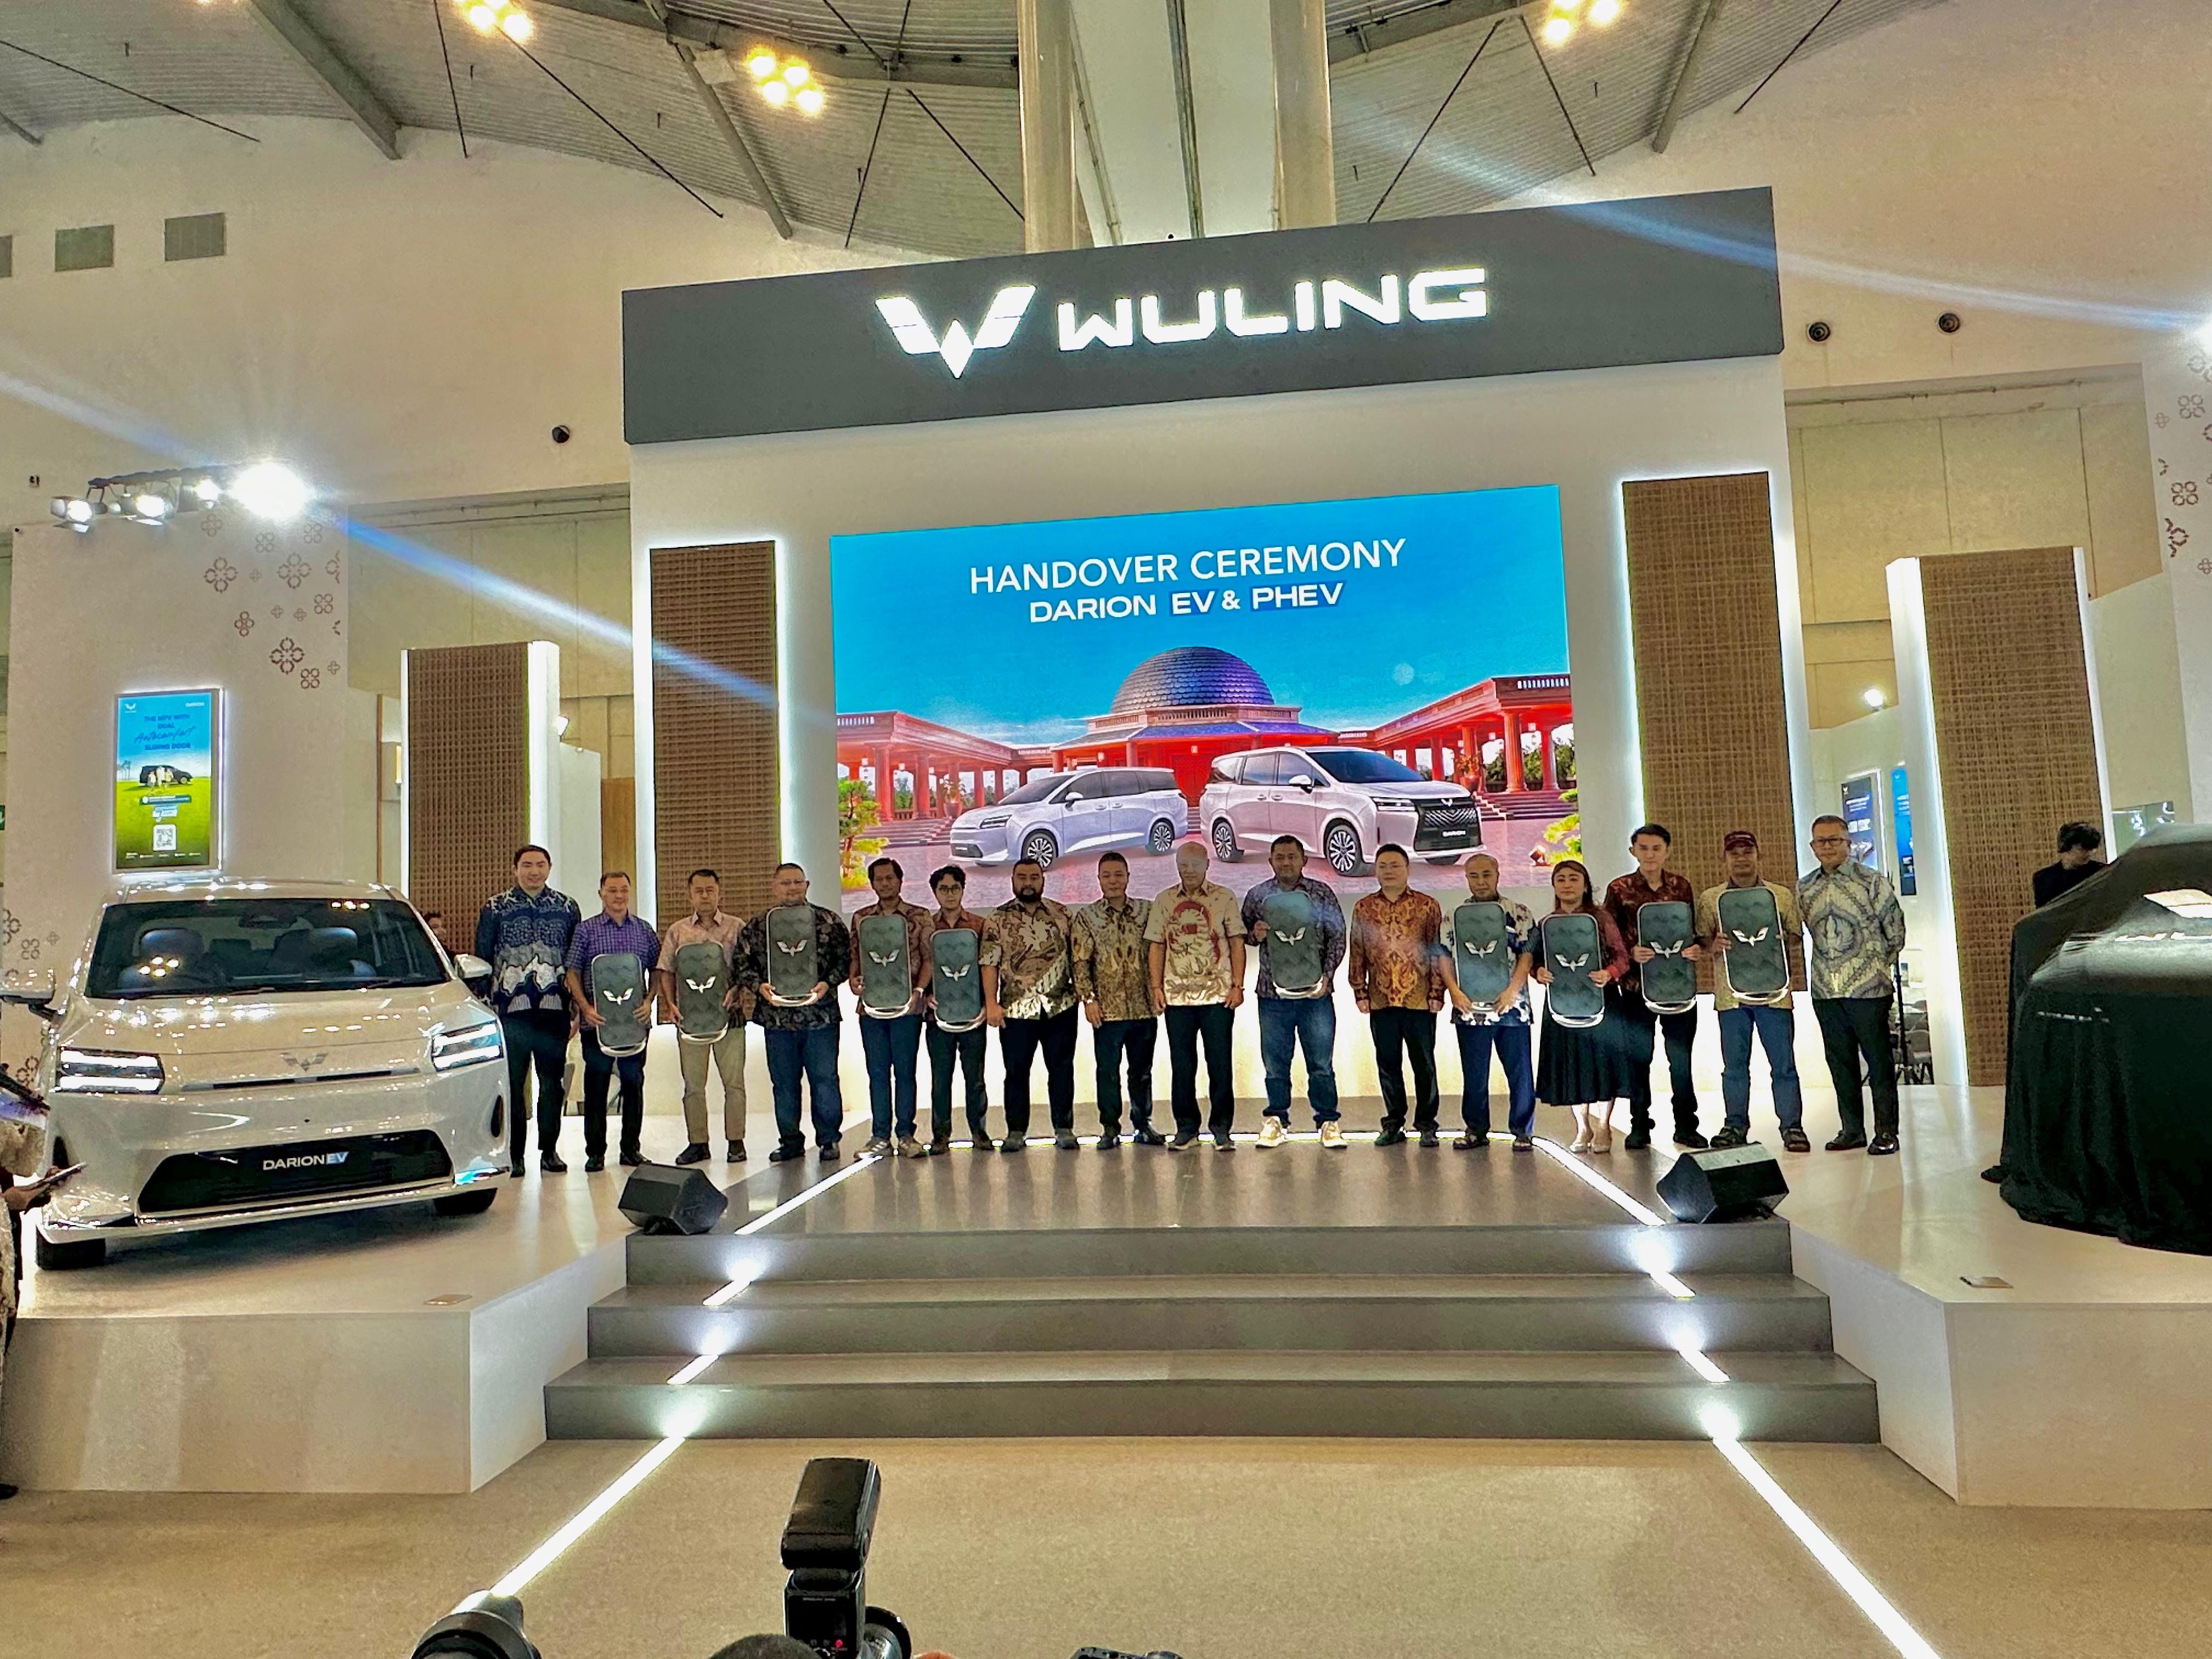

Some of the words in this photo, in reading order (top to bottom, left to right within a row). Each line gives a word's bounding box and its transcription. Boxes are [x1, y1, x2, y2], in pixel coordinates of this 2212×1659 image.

[1058, 268, 1487, 352] WULING
[970, 554, 1178, 594] HANDOVER
[1190, 538, 1406, 579] CEREMONY
[1030, 595, 1156, 623] DARION
[1172, 591, 1215, 614] EV
[1221, 590, 1241, 610] &
[1252, 583, 1343, 610] PHEV
